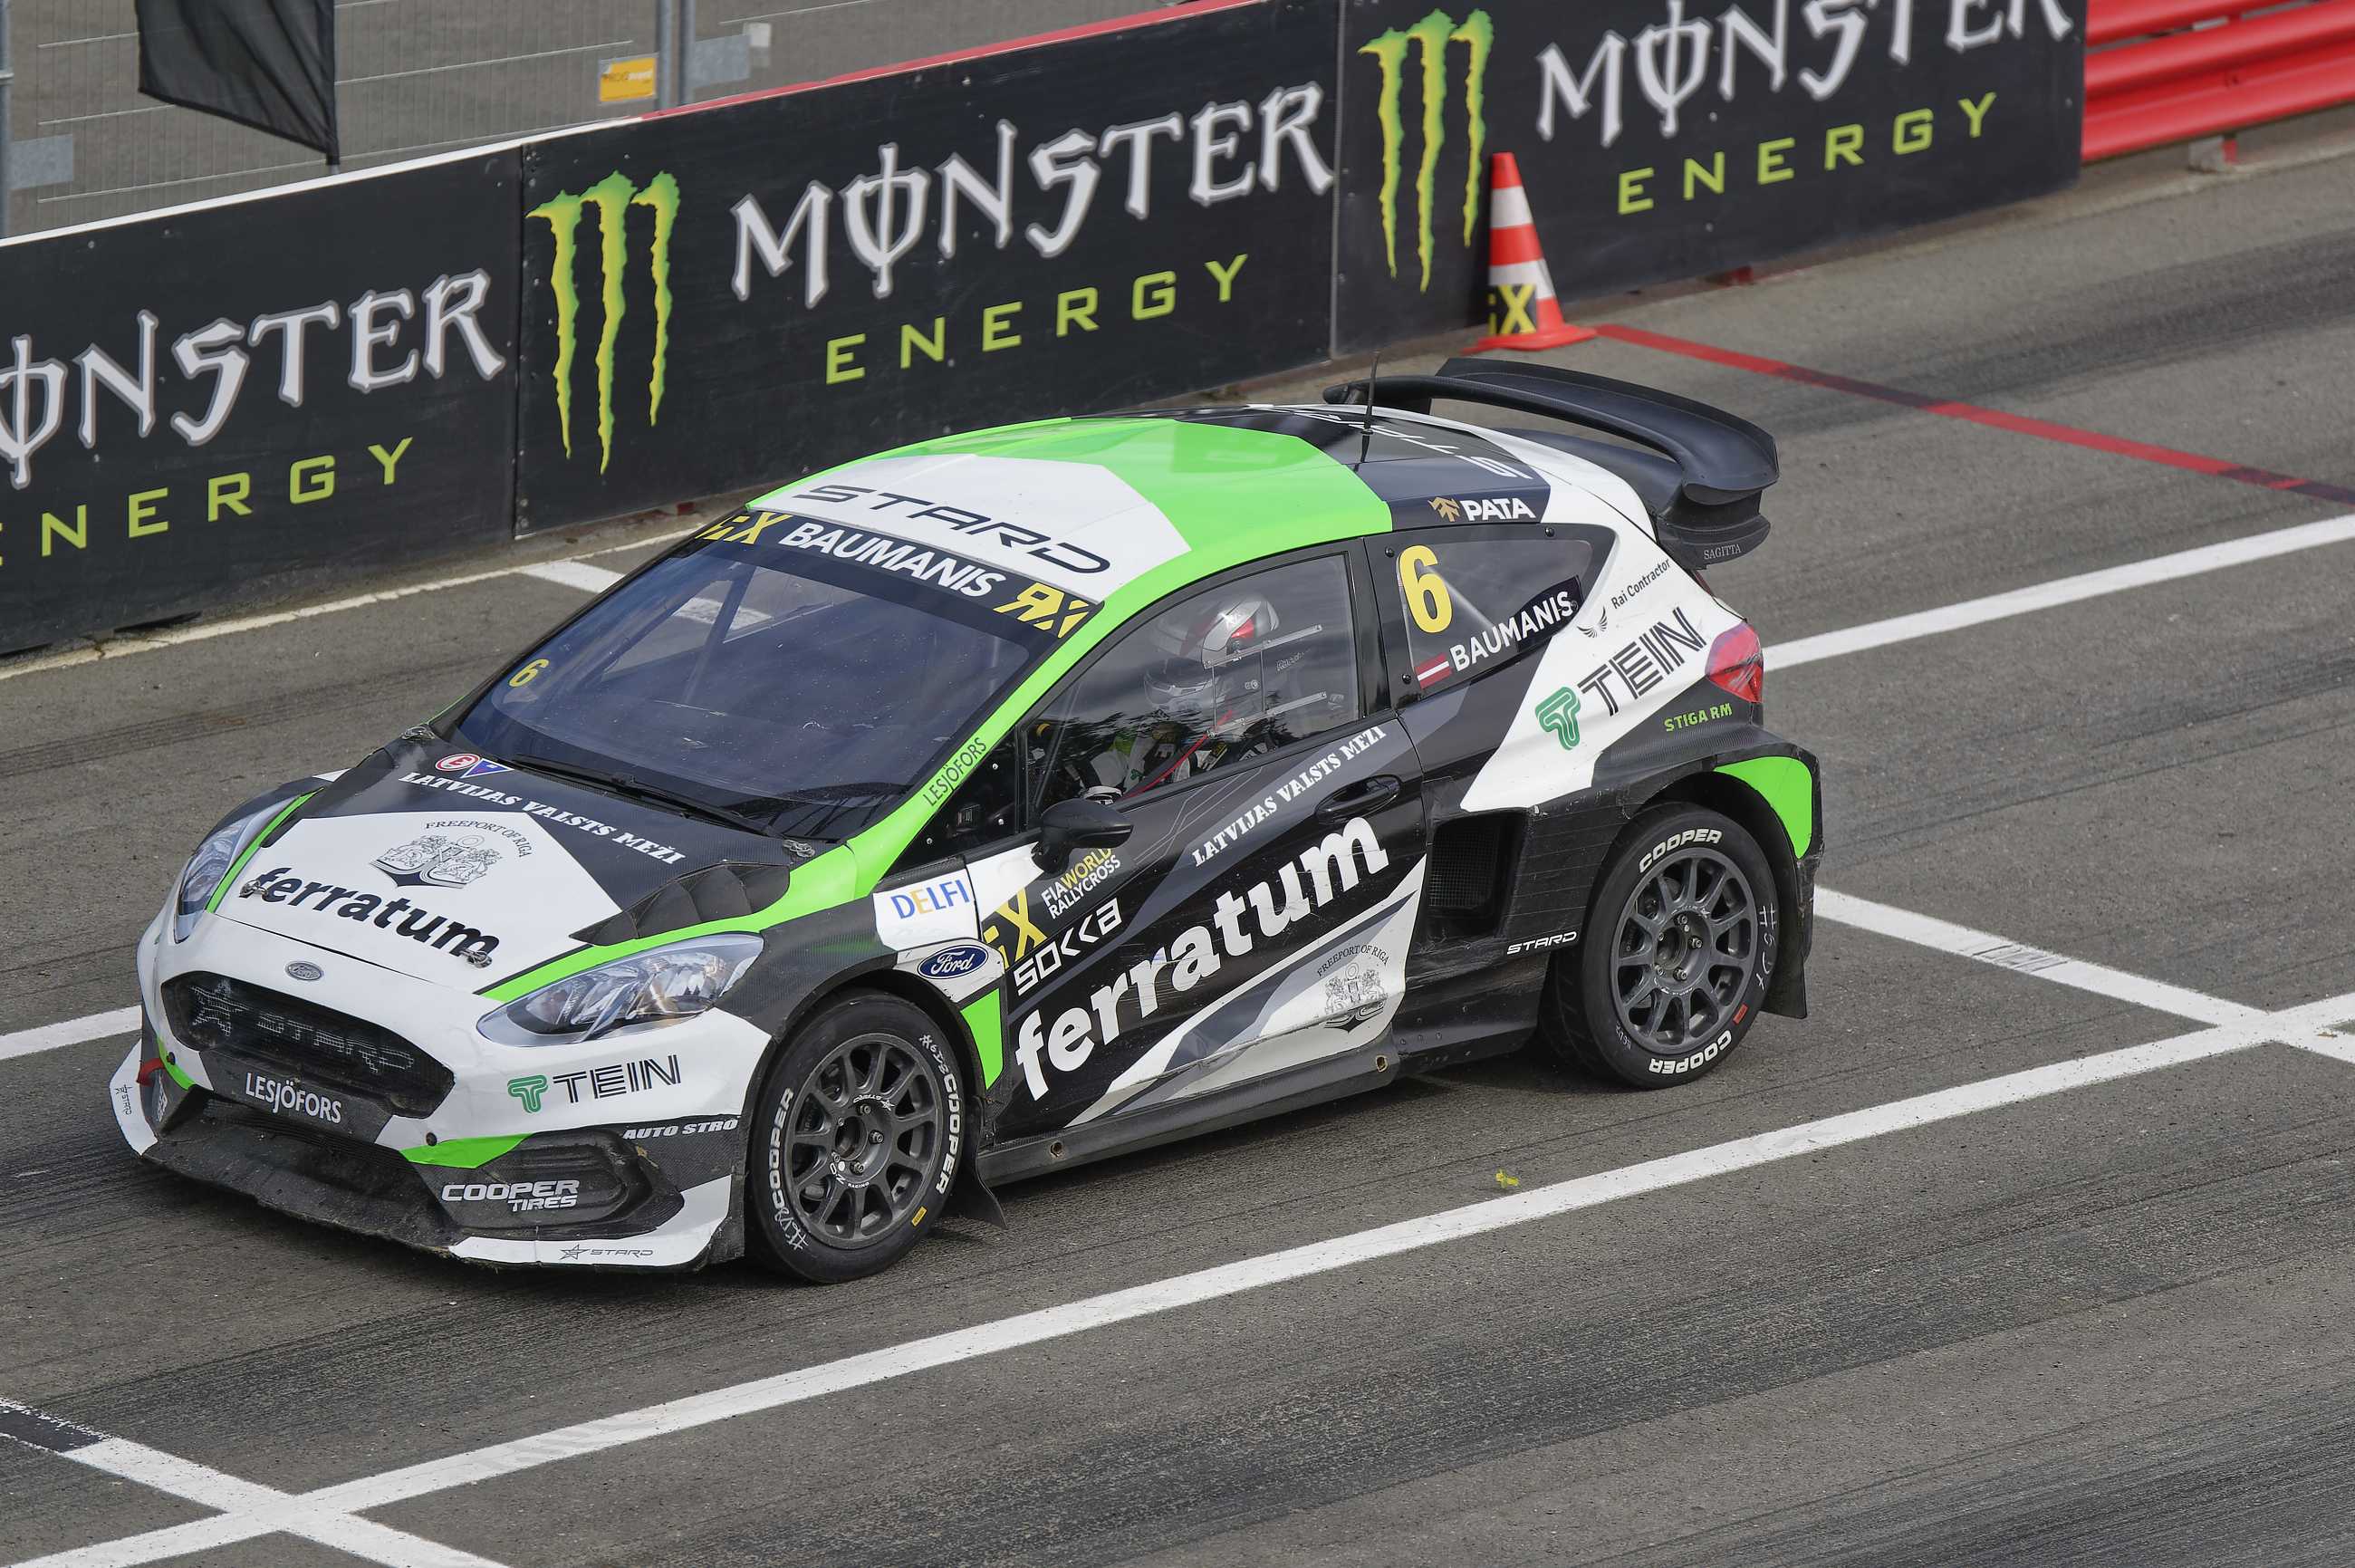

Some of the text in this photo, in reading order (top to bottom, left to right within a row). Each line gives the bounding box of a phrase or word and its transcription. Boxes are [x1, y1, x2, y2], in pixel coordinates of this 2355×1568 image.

[1619, 91, 1996, 215] ENERGY
[731, 82, 1335, 308] MONSTER
[826, 254, 1248, 385] ENERGY
[0, 438, 413, 565] NERGY
[1460, 497, 1536, 522] PATA
[793, 485, 1110, 573] STARD
[1704, 544, 1741, 561] SAGITTA
[778, 522, 1006, 597] BAUMANIS
[1610, 558, 1671, 610] Rai Contractor
[1398, 544, 1452, 633] 6
[1449, 591, 1573, 672] BAUMANIS
[509, 659, 550, 687] 6
[1576, 606, 1707, 717] TEIN
[1664, 702, 1733, 732] STIGA RM
[923, 736, 986, 807] LESJÖFORS
[398, 772, 687, 864] LATVIJAS VALSTS MEŽI
[1192, 796, 1277, 867] LATVIJAS
[1276, 753, 1341, 803] VALSTS
[426, 820, 533, 858] FREEPORT OF RIGA
[1639, 828, 1722, 872] COOPER
[239, 867, 500, 957] ferratum
[891, 879, 969, 919] DELFI
[1048, 854, 1121, 919] RALLYCROSS
[930, 950, 975, 975] Ford
[1014, 816, 1389, 1101] ferratum
[1317, 944, 1389, 976] FREEPORT OF RIGA
[1506, 931, 1577, 955] STARD
[1648, 1030, 1732, 1074] COOPER
[245, 1072, 341, 1124] LESJÖFORS
[553, 1054, 681, 1103] TEIN
[623, 1126, 678, 1140] AUTO
[769, 1088, 794, 1210] COOPER
[935, 1073, 961, 1195] COOPER
[441, 1179, 580, 1202] COOPER
[507, 1194, 579, 1212] TIRES
[590, 1249, 653, 1258] STARD
